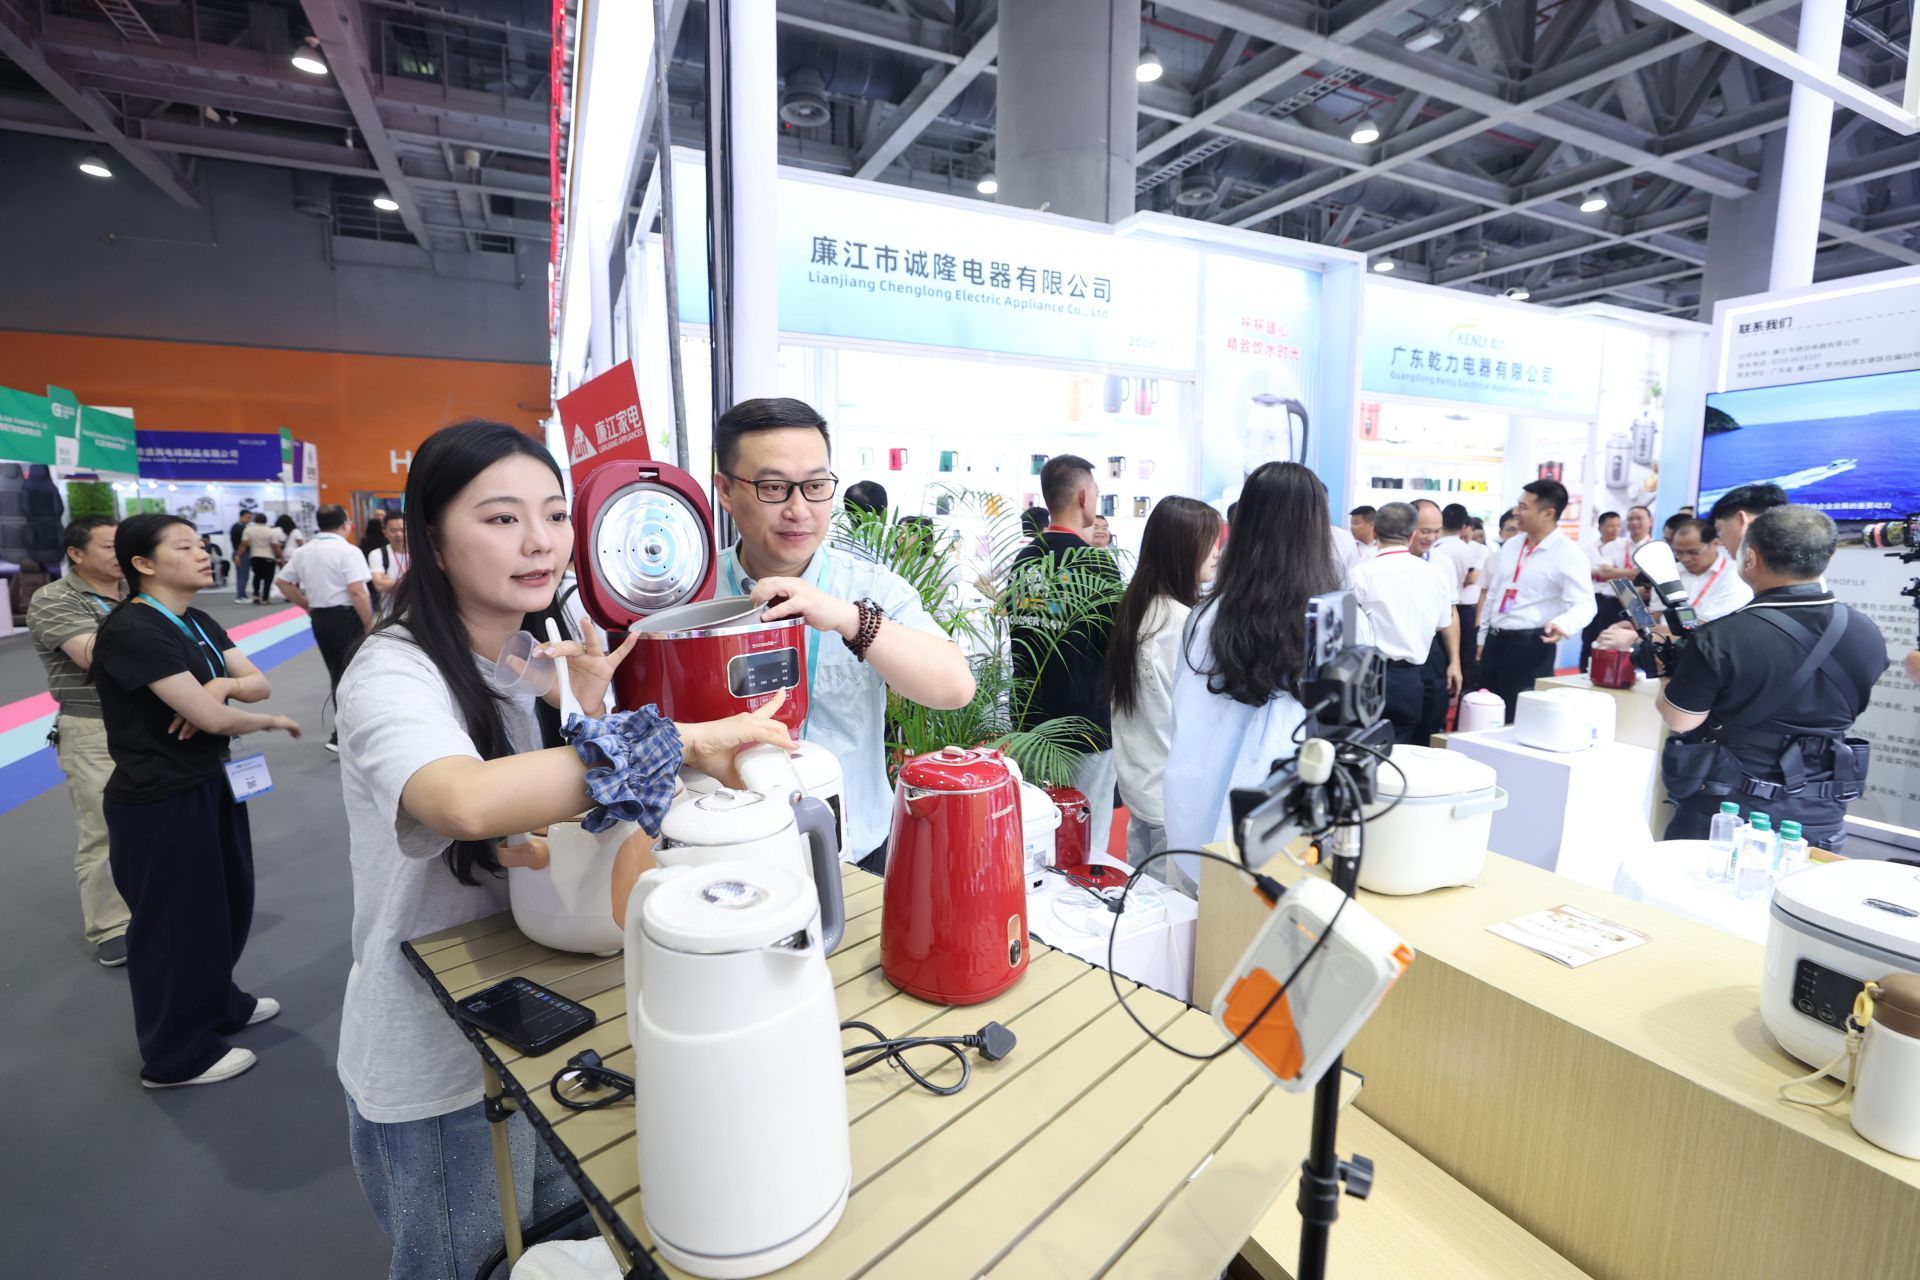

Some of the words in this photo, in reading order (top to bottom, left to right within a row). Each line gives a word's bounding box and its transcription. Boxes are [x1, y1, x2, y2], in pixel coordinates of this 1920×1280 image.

[810, 236, 1112, 303] 廉江市诚隆电器有限公司
[808, 270, 876, 292] Lianjiang
[879, 280, 952, 301] Chenglong
[955, 289, 1001, 305] Electric
[1004, 296, 1064, 313] Appliance
[1738, 317, 1793, 334] 联系我们
[1227, 337, 1301, 361] 精致饮水时光
[1391, 345, 1552, 385] 广东乾力电器有限公司
[594, 405, 642, 445] 廉江家电
